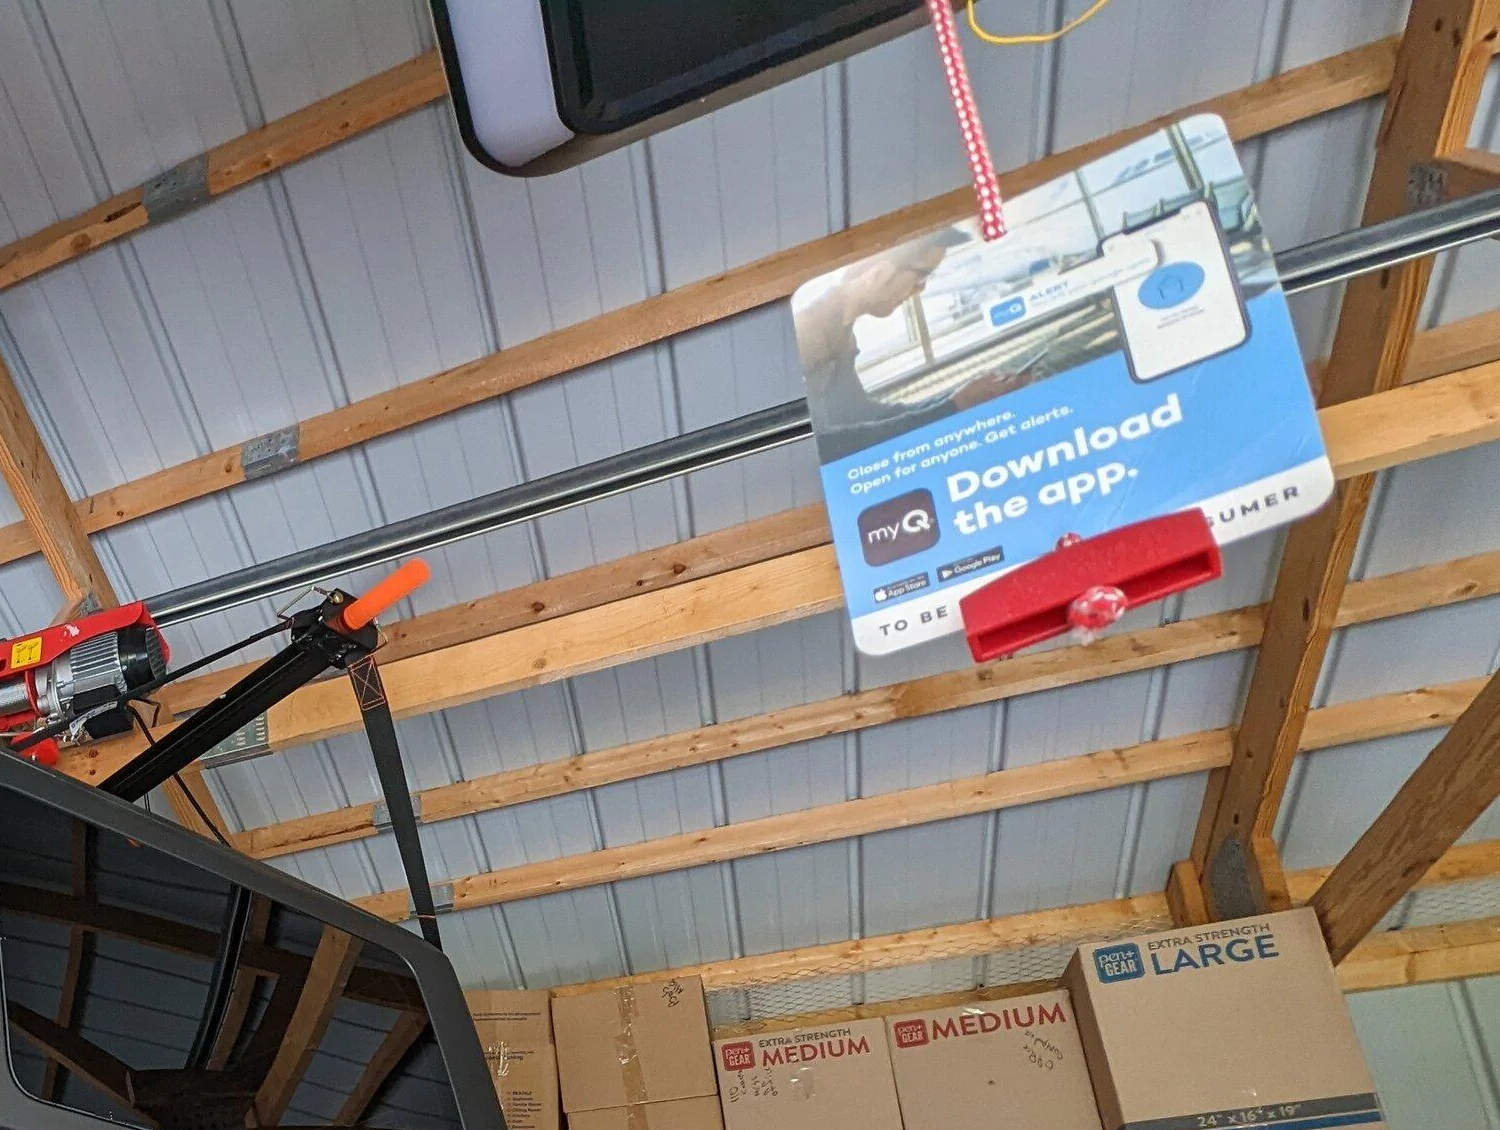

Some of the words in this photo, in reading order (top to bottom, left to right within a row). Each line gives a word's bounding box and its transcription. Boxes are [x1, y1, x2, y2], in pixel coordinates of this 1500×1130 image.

[847, 457, 889, 481] Close
[892, 442, 930, 464] from
[933, 410, 1017, 451] anywhere.
[850, 474, 892, 496] Open
[895, 464, 917, 479] for
[920, 441, 982, 468] anyone.
[985, 425, 1017, 444] Get
[1020, 405, 1075, 432] alerts.
[946, 392, 1184, 503] Download
[952, 494, 1029, 536] the
[1037, 459, 1140, 505] app.
[868, 509, 931, 544] myQ
[954, 559, 983, 574] Google
[983, 551, 1001, 564] Play
[887, 586, 905, 598] App
[905, 579, 927, 592] Store
[879, 619, 908, 636] TO
[920, 605, 948, 624] BE
[1147, 935, 1193, 951] EXTRA
[1196, 922, 1271, 943] STRENGTH
[1105, 960, 1138, 977] GEAR
[1150, 933, 1280, 976] LARGE
[901, 1029, 924, 1043] GEAR
[932, 1002, 1067, 1040] MEDIUM
[758, 1036, 793, 1049] EXTRA
[794, 1027, 852, 1043] STRENGTH
[762, 1035, 871, 1068] MEDIUM
[729, 1054, 751, 1068] GEAR
[1197, 1113, 1222, 1127] 24"
[1228, 1115, 1237, 1125] x
[1267, 1110, 1276, 1119] x
